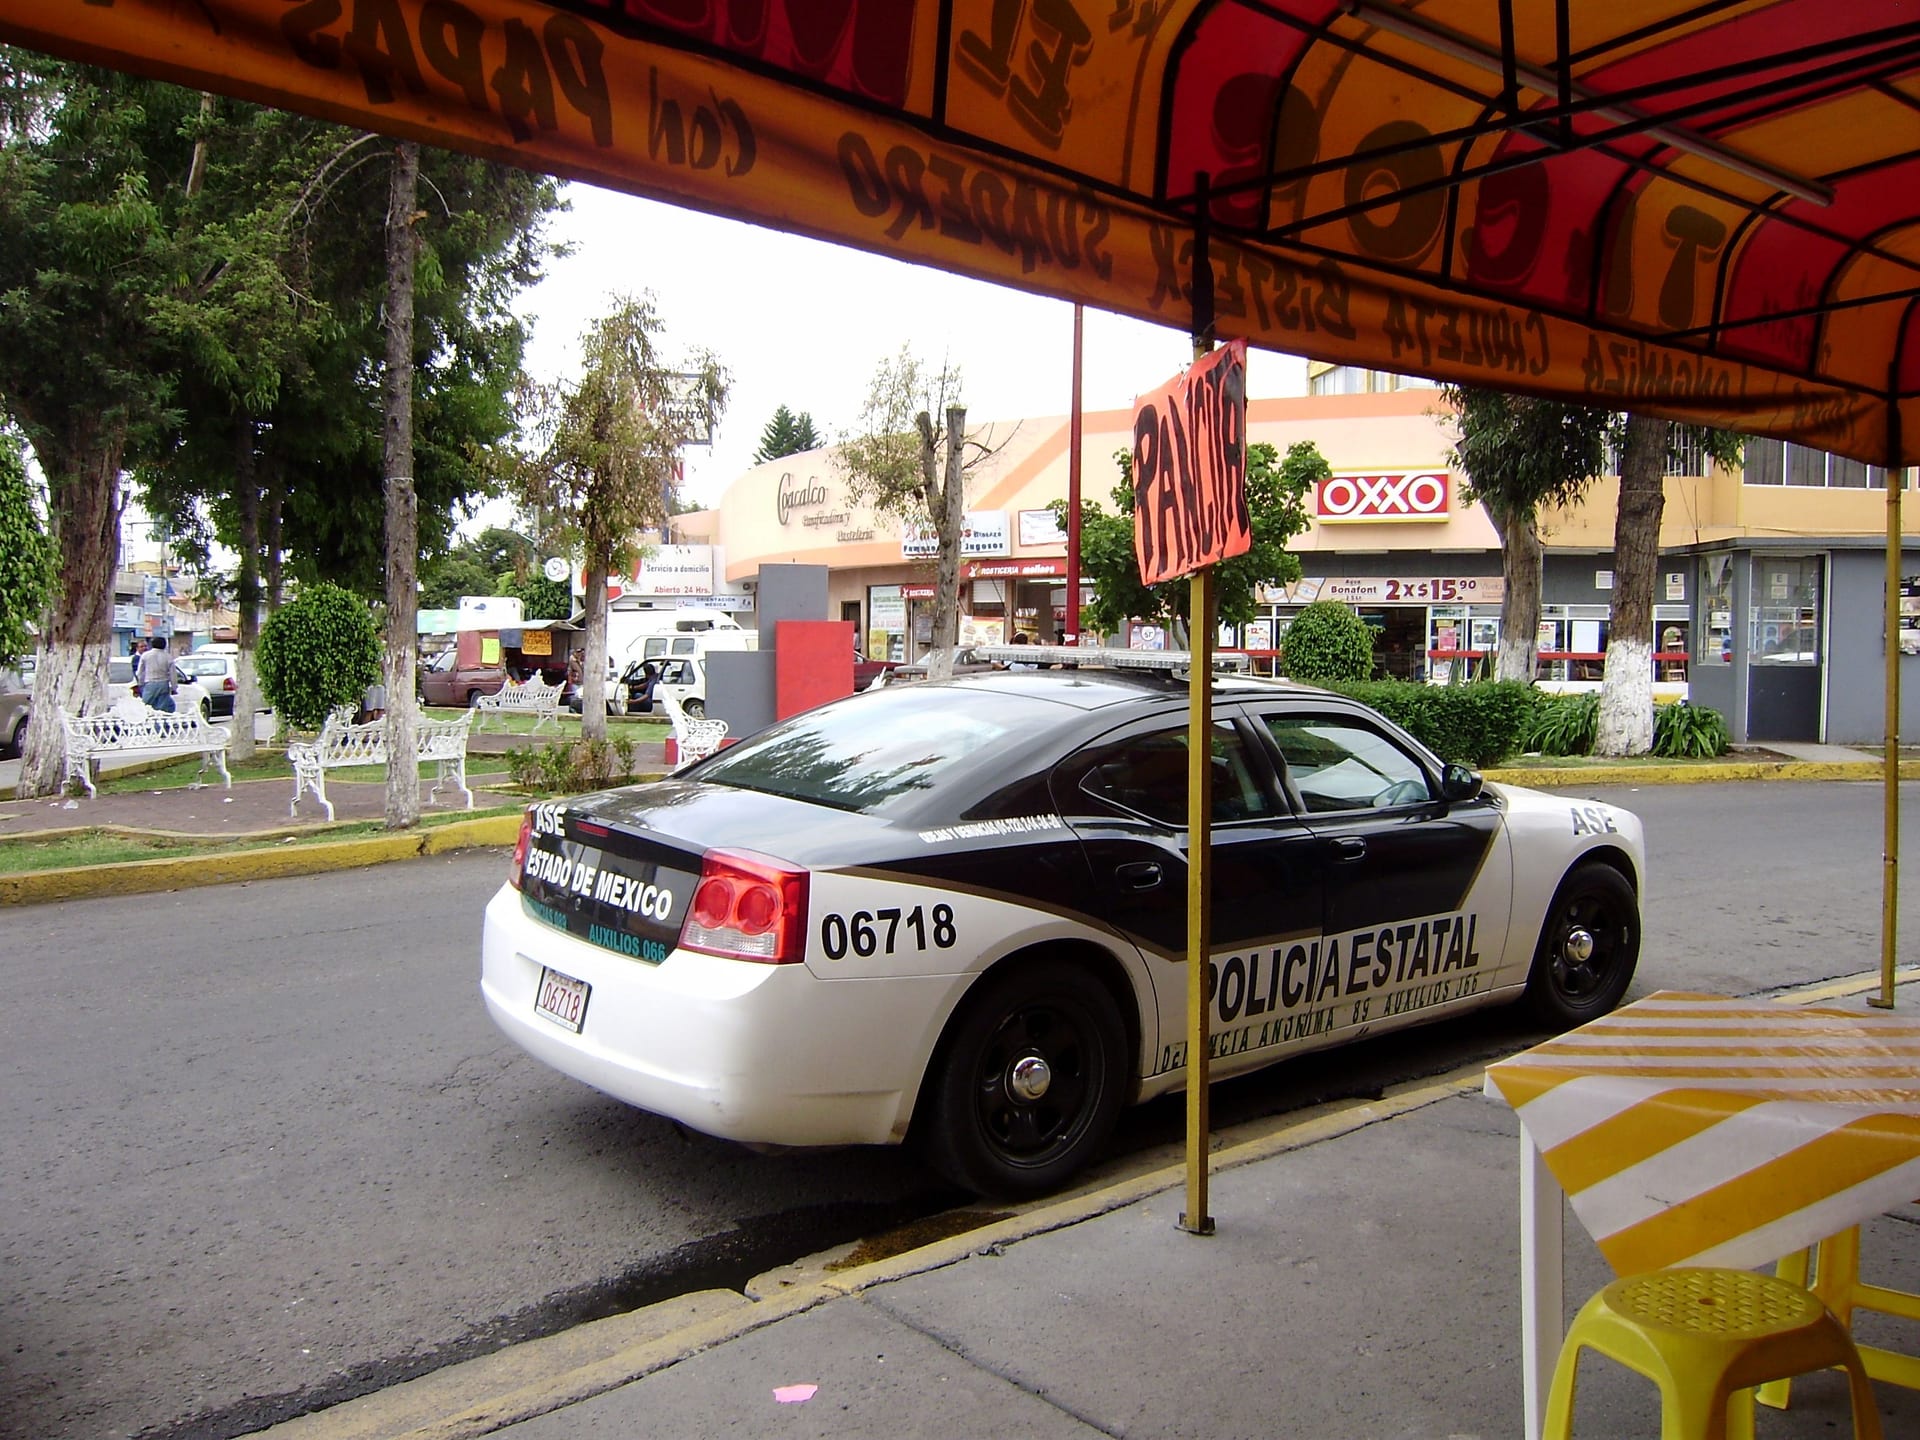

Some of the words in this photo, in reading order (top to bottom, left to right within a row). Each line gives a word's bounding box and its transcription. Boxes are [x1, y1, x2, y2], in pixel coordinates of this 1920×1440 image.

[1322, 473, 1445, 515] OXXO
[903, 544, 940, 553] Famoso
[965, 542, 1004, 552] Jugosos
[646, 564, 673, 573] Servicio
[680, 564, 710, 573] domicilio
[654, 585, 680, 594] Abierto
[684, 585, 693, 594] 24
[1331, 585, 1377, 594] Bonafont
[535, 803, 568, 837] ASE
[1570, 807, 1617, 836] ASE
[526, 847, 572, 888] ESTADO
[572, 862, 597, 897] DE
[594, 870, 673, 922] MEXICO
[588, 924, 640, 957] AUXILIOS
[643, 939, 667, 962] 066
[821, 903, 957, 961] 06718
[1345, 914, 1479, 995] ESTATAL
[543, 981, 581, 1022] 06718
[1384, 980, 1450, 1016] AUXILIOS
